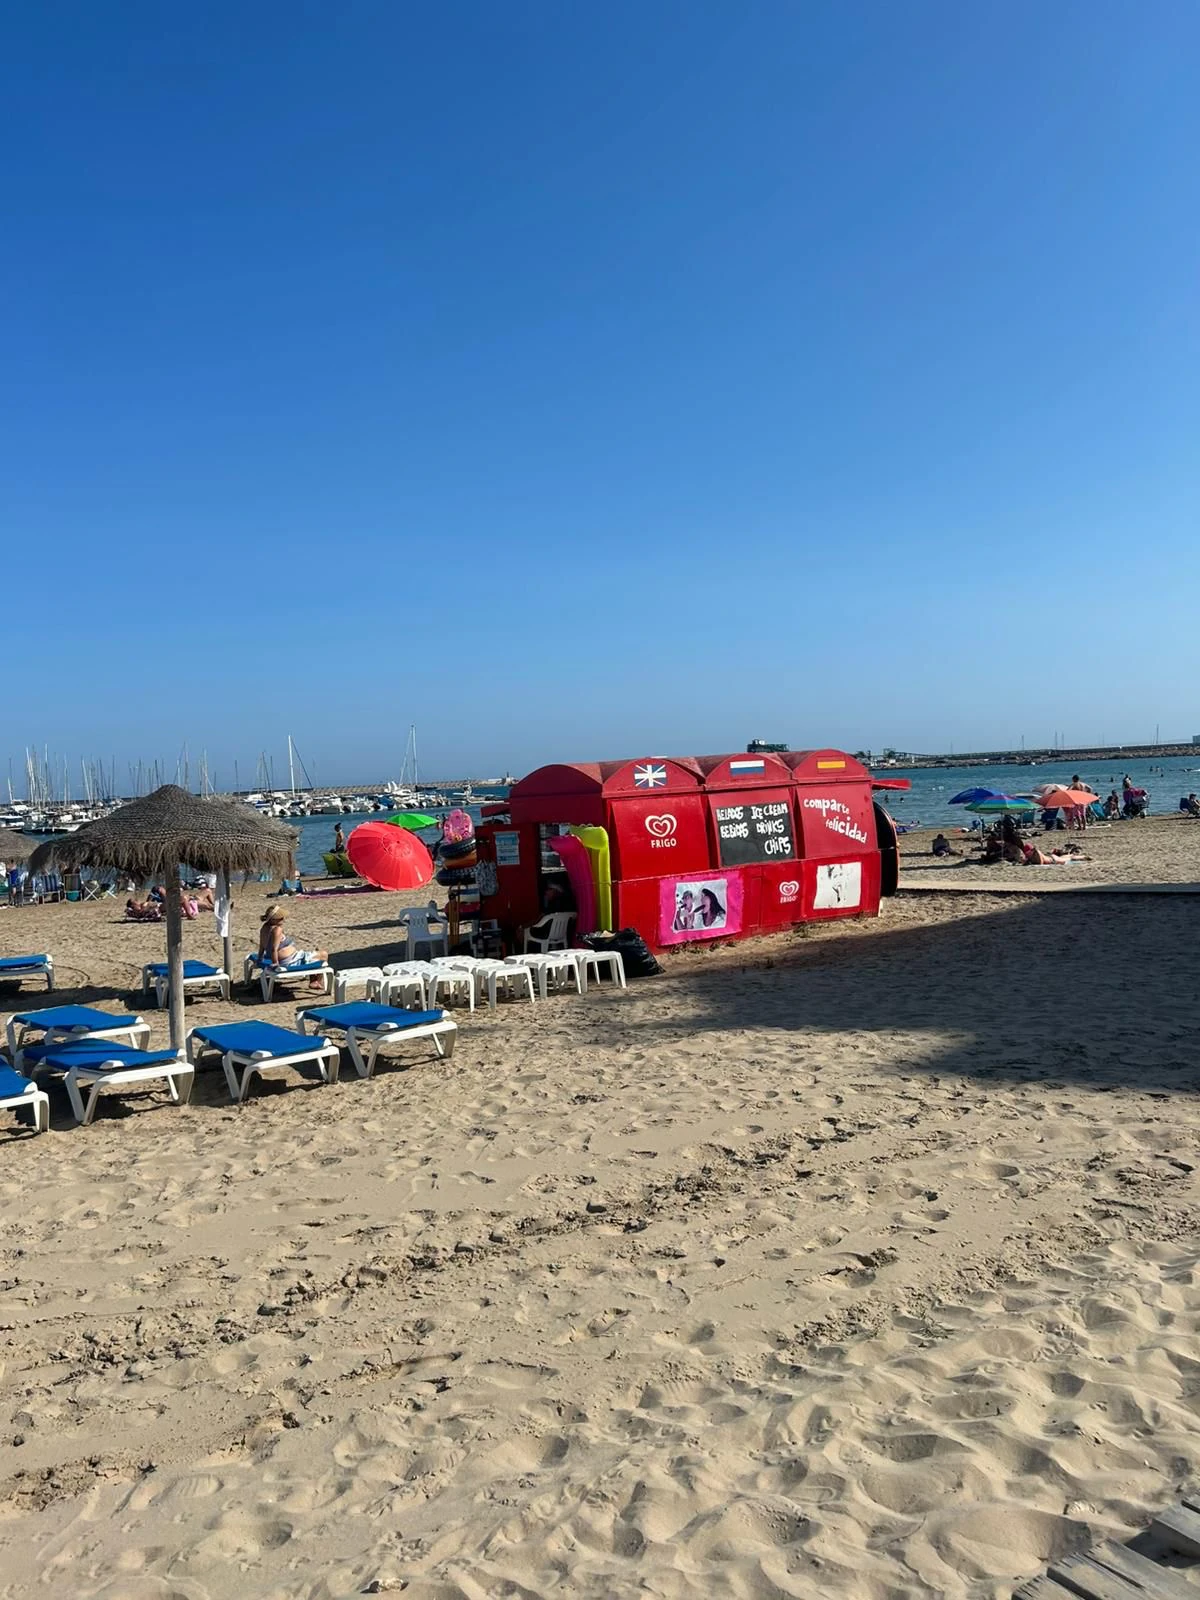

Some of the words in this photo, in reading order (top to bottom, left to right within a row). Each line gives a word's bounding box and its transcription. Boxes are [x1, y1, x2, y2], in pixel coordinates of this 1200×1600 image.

[751, 805, 763, 820] ICE
[763, 803, 788, 817] CREAM
[803, 798, 849, 817] comparte
[825, 816, 868, 844] felicidad
[651, 838, 677, 848] FRIGO
